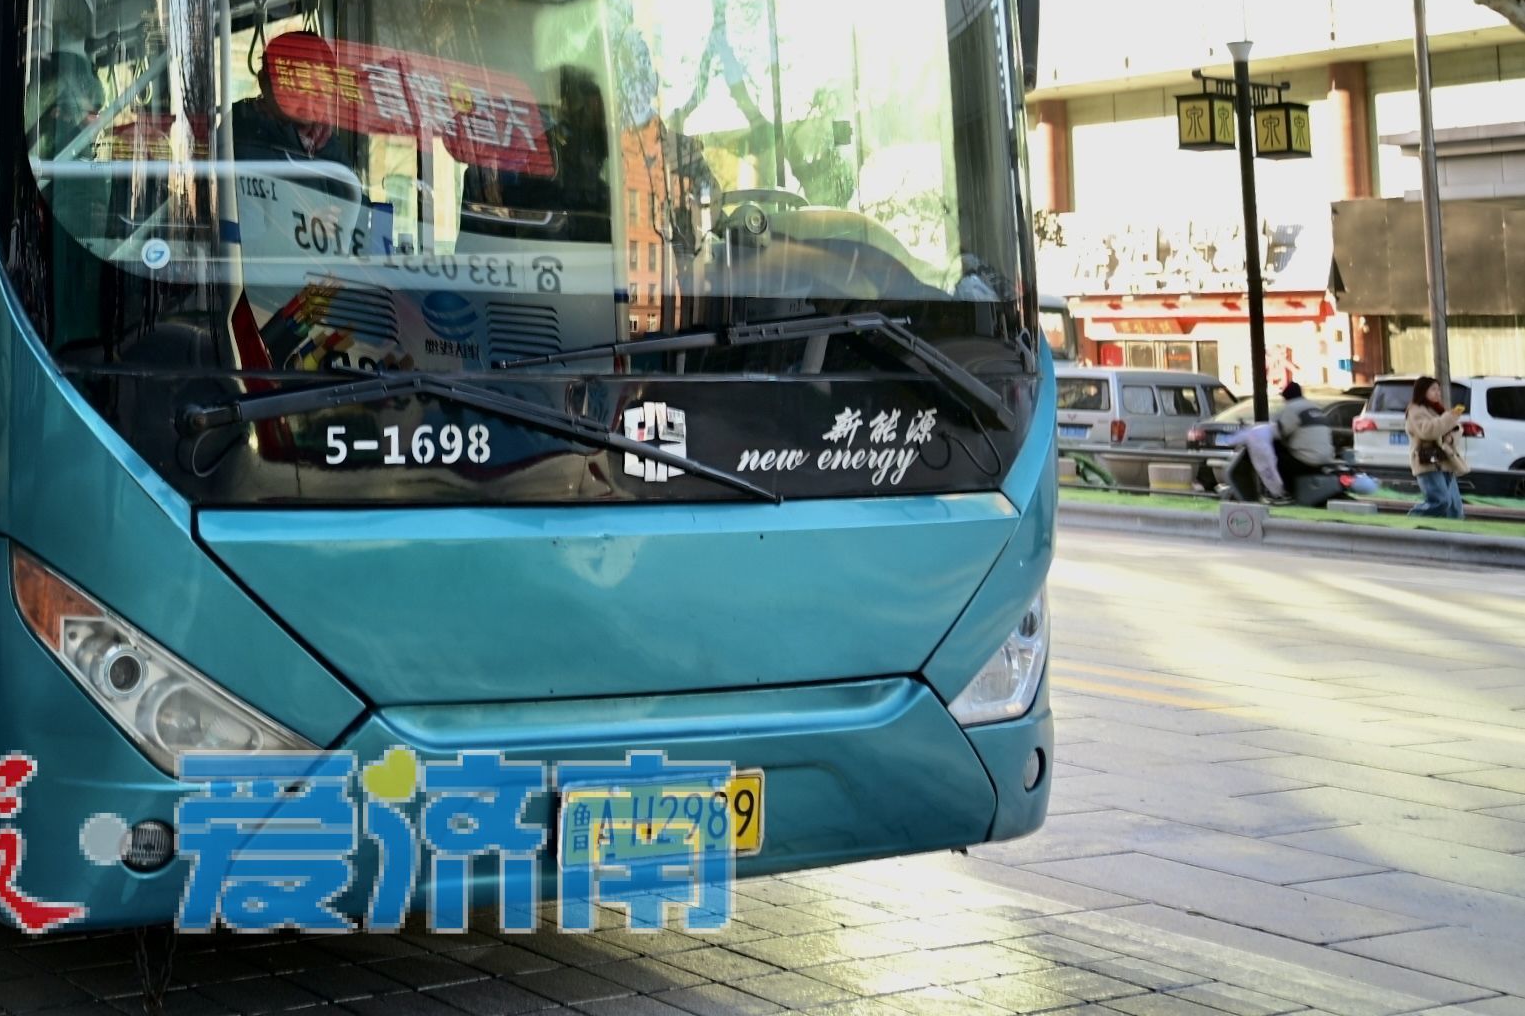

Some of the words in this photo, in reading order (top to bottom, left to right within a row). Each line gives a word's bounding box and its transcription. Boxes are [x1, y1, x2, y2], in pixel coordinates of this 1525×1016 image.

[326, 424, 492, 465] 5-1698
[822, 406, 939, 449] 新能源
[737, 448, 811, 472] new
[817, 446, 920, 486] energy
